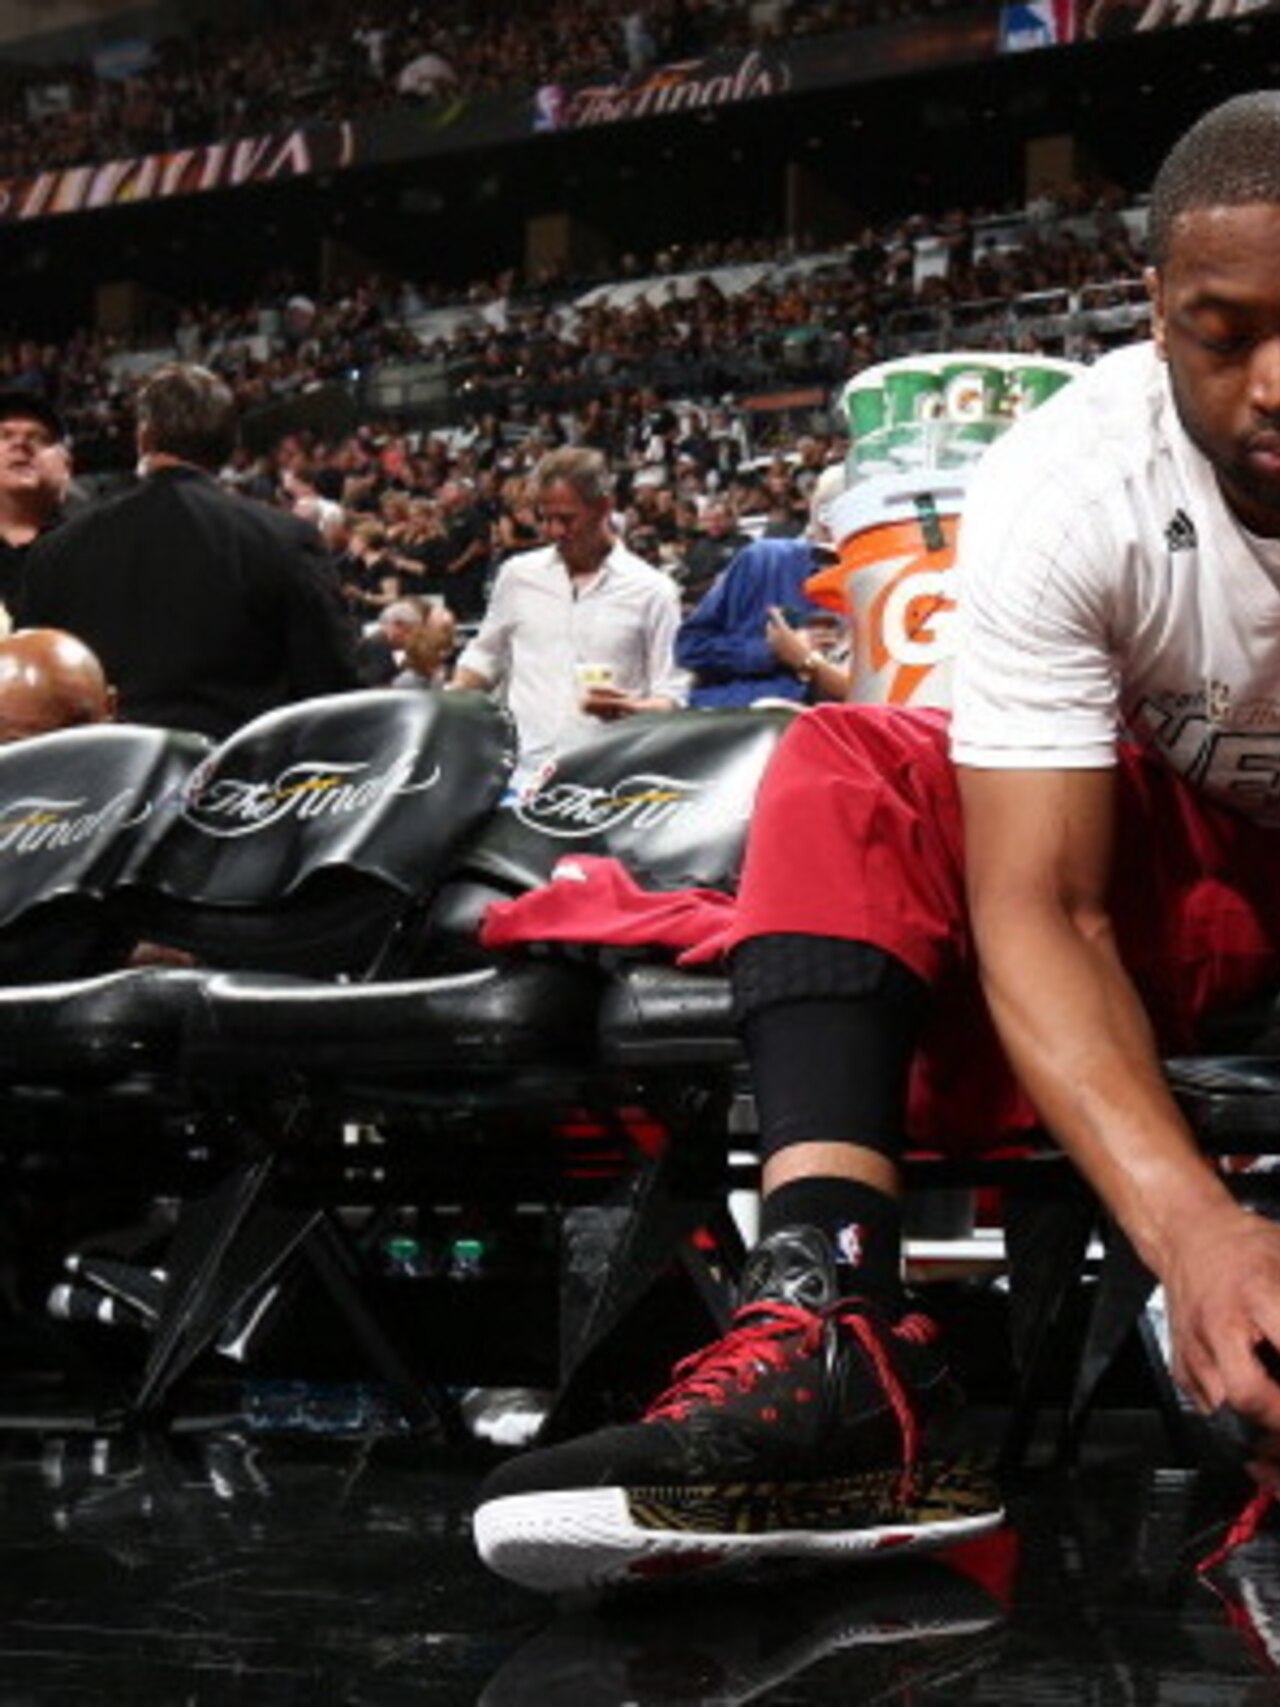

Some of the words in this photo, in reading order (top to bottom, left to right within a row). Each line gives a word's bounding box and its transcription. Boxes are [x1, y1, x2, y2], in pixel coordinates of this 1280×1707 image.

[572, 86, 628, 125] The
[630, 52, 773, 117] Finals
[943, 371, 985, 422] G
[882, 568, 957, 664] G
[209, 779, 276, 820] The
[531, 784, 612, 823] The
